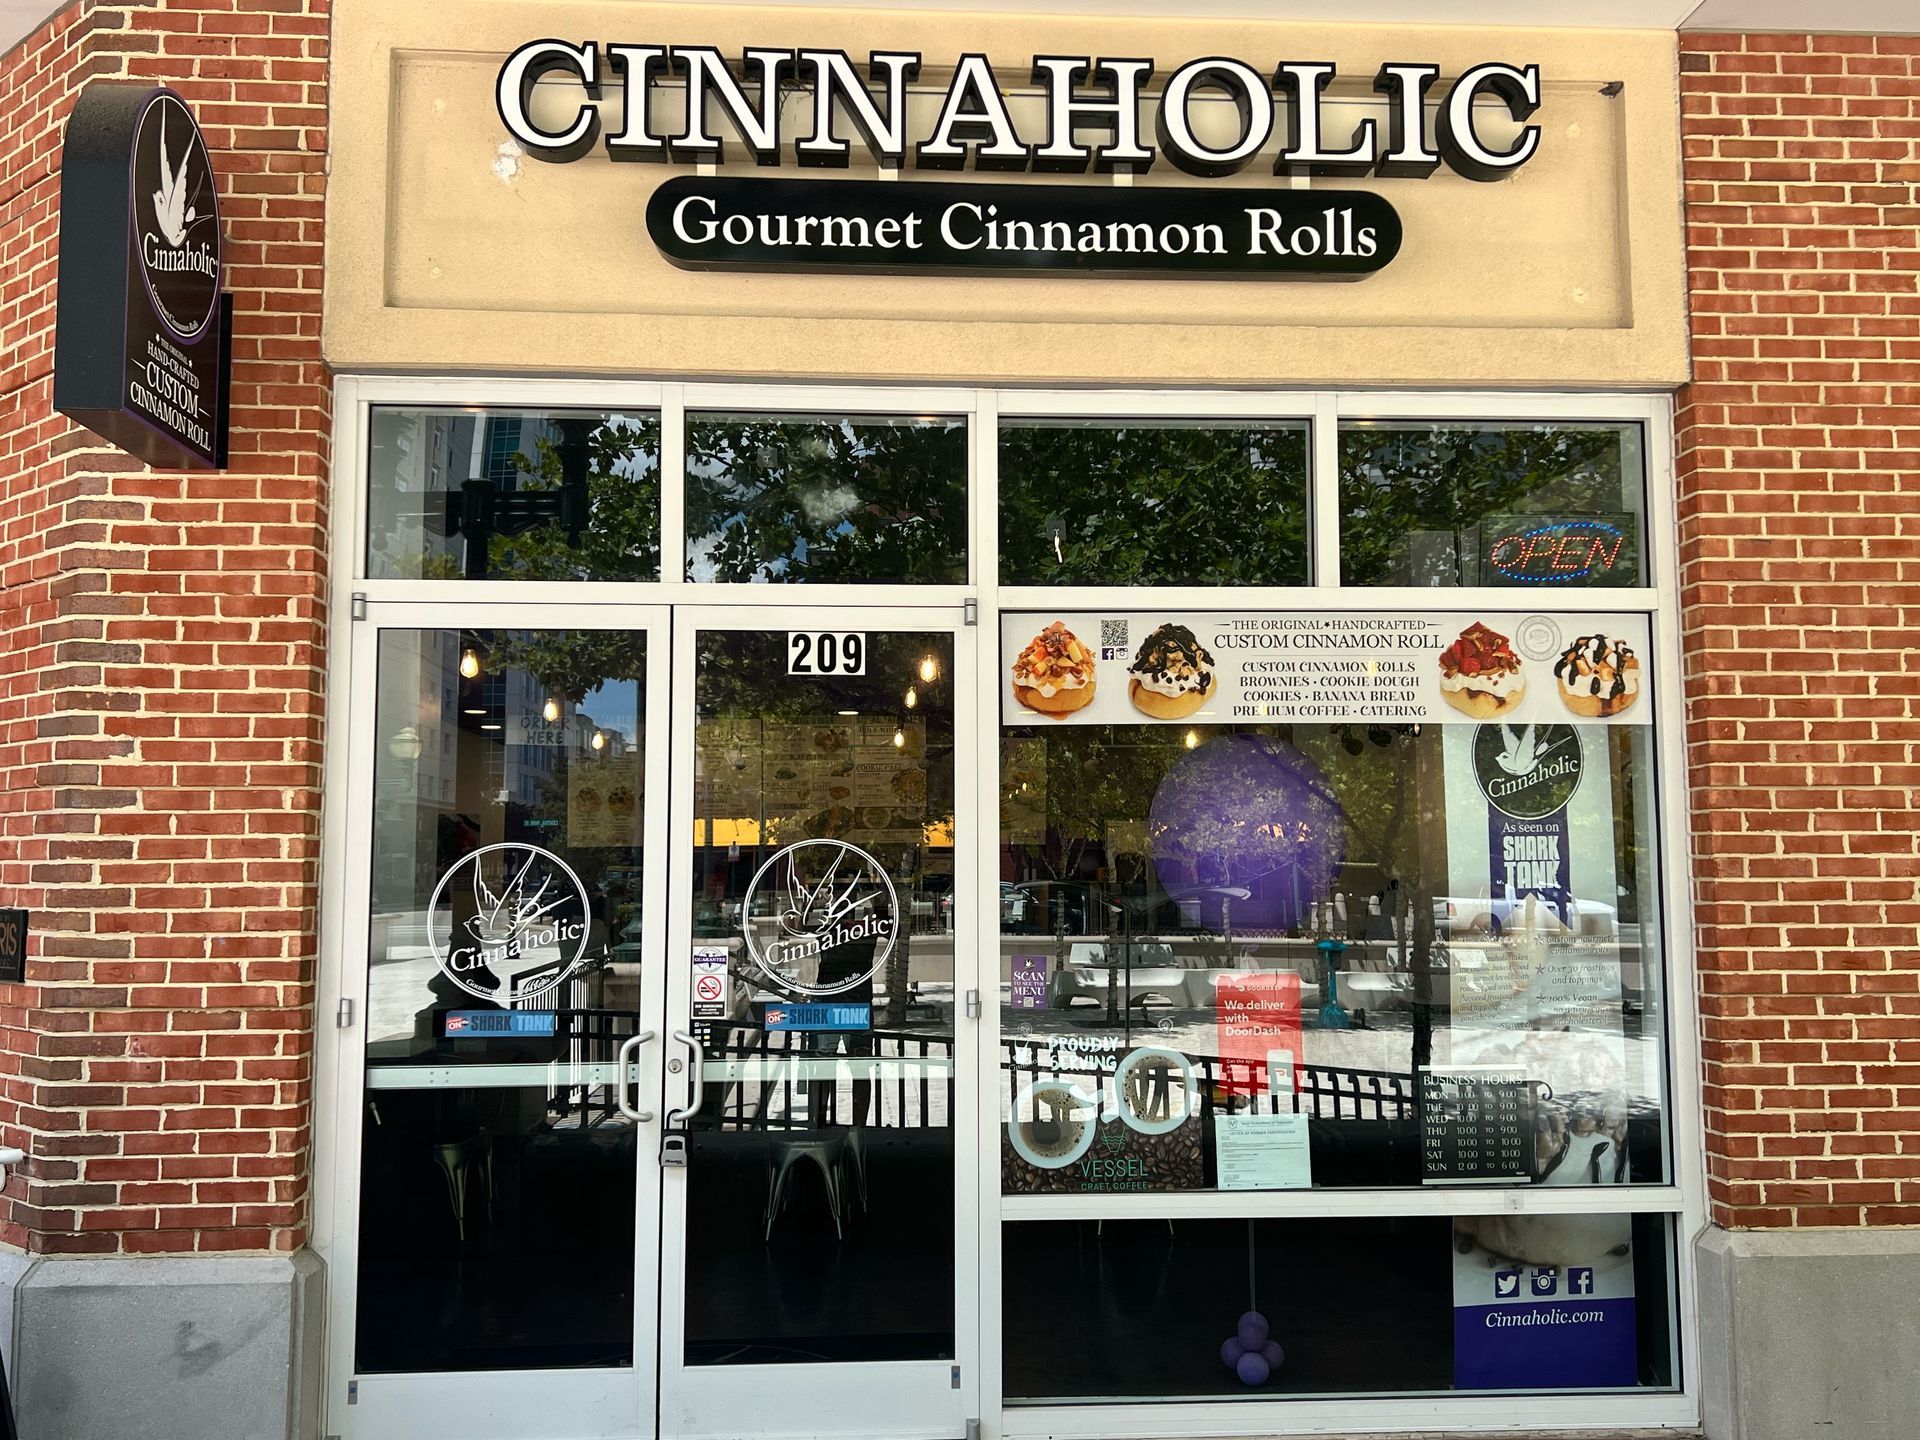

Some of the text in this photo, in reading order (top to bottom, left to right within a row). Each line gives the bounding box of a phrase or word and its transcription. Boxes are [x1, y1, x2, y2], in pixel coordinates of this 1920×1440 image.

[497, 39, 1541, 172] CINNAHOLIC
[672, 196, 1378, 256] Gourmet Cinnamon Rolls
[143, 232, 216, 278] Cinnaholic
[147, 340, 199, 389] HAND-CRAFTED
[147, 361, 199, 418] CUSTOM
[130, 381, 211, 452] CINNAMON ROLL
[1491, 536, 1623, 569] OPEN
[1232, 620, 1426, 630] THE ORIGINAL HANDCRAFTED
[1214, 634, 1444, 649] CUSTOM CINNAMON ROLL
[791, 633, 862, 673] 209
[1242, 661, 1296, 672] CUSTOM
[1299, 661, 1368, 673] CINNAMON
[1240, 676, 1420, 687] BROWNIES COOKIE DOUGH
[1243, 691, 1415, 702] COOKIES BANANA BREAD
[1299, 705, 1350, 716] COFFEE
[1360, 705, 1427, 716] CATERING
[527, 731, 564, 744] HERE
[1488, 755, 1579, 798] Cinnaholic
[1503, 822, 1559, 832] As seen on
[1503, 836, 1560, 860] SHARK
[1504, 861, 1561, 889] TANK
[450, 917, 581, 972] Cinnaholic
[765, 913, 890, 965] Cinnaholic
[844, 972, 861, 983] Rolls
[1013, 971, 1045, 981] SCAN
[1552, 976, 1567, 984] and
[1013, 987, 1045, 996] MENU
[1573, 993, 1598, 1002] Vegan
[1224, 1000, 1285, 1010] We deliver
[768, 1015, 781, 1023] ON
[789, 1008, 868, 1024] SHARK TANK
[1225, 1013, 1249, 1023] with
[471, 1015, 553, 1031] SHARK TANK
[1225, 1026, 1281, 1036] DoorDash
[1050, 1055, 1117, 1071] SERVING
[1423, 1074, 1523, 1085] BUSINESS HOURS
[1425, 1091, 1449, 1100] MON
[1426, 1103, 1443, 1112] TUE
[1426, 1115, 1448, 1123] WED
[1426, 1127, 1447, 1135] THU
[1426, 1139, 1441, 1147] FRI
[1427, 1151, 1443, 1159] SAT
[1081, 1160, 1149, 1177] VESSEL
[1427, 1163, 1447, 1171] SUN
[1081, 1181, 1148, 1191] CRAFT COFFEE
[1485, 1309, 1604, 1328] Cinnaholic.com
